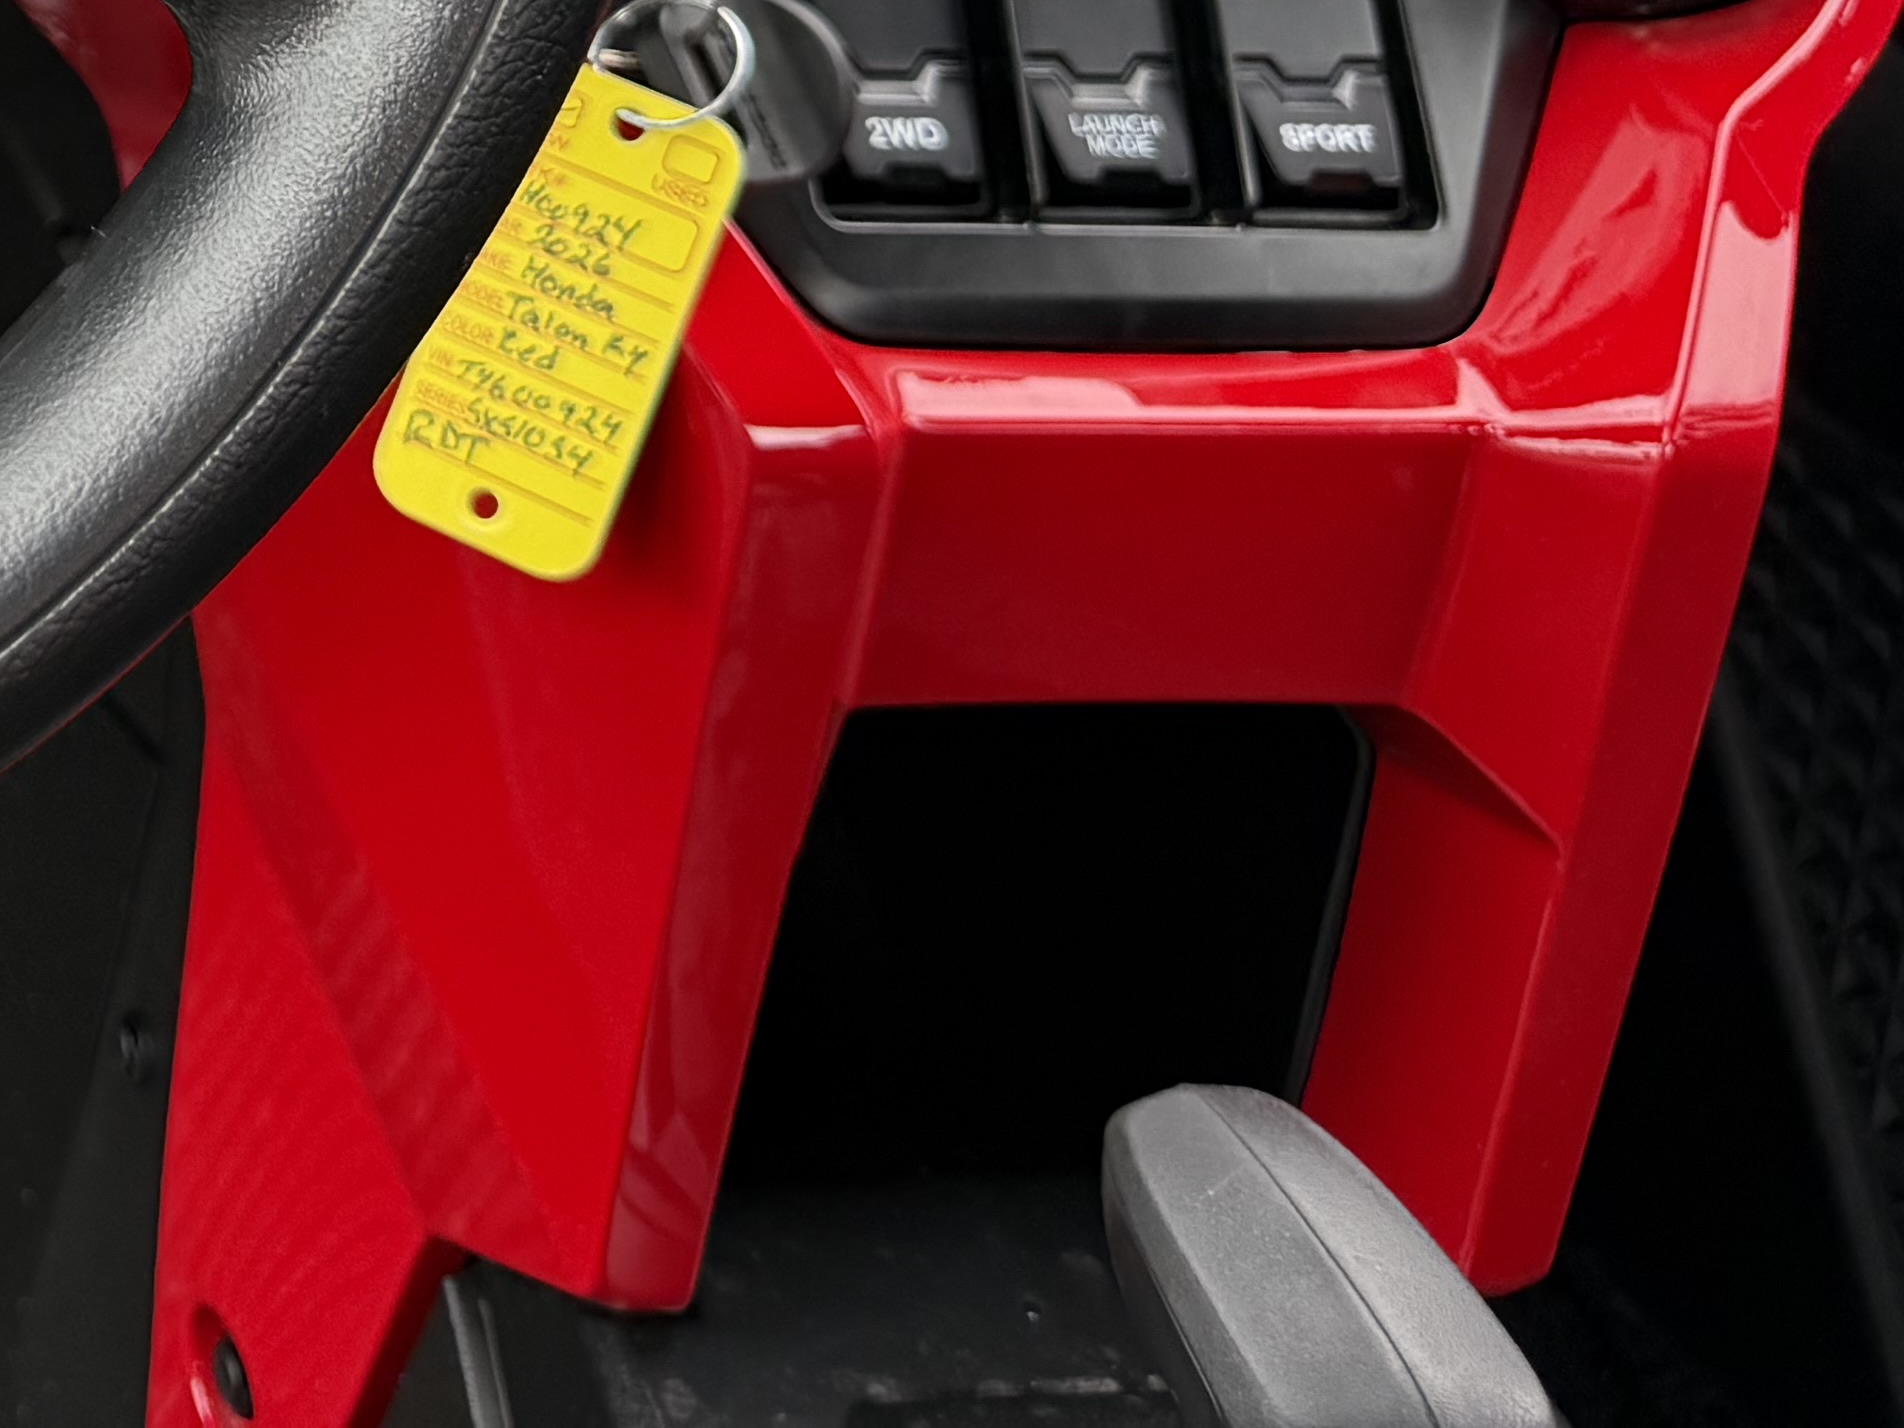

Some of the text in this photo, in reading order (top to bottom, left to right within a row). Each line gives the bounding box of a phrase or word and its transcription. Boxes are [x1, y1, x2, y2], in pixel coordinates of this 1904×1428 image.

[864, 116, 950, 151] 2WD
[1068, 112, 1168, 138] LAUNCH
[1279, 122, 1377, 153] SPORT
[1086, 134, 1158, 160] MODE
[526, 224, 610, 276] 2026
[521, 255, 615, 323] Honda
[506, 291, 589, 351] Talon
